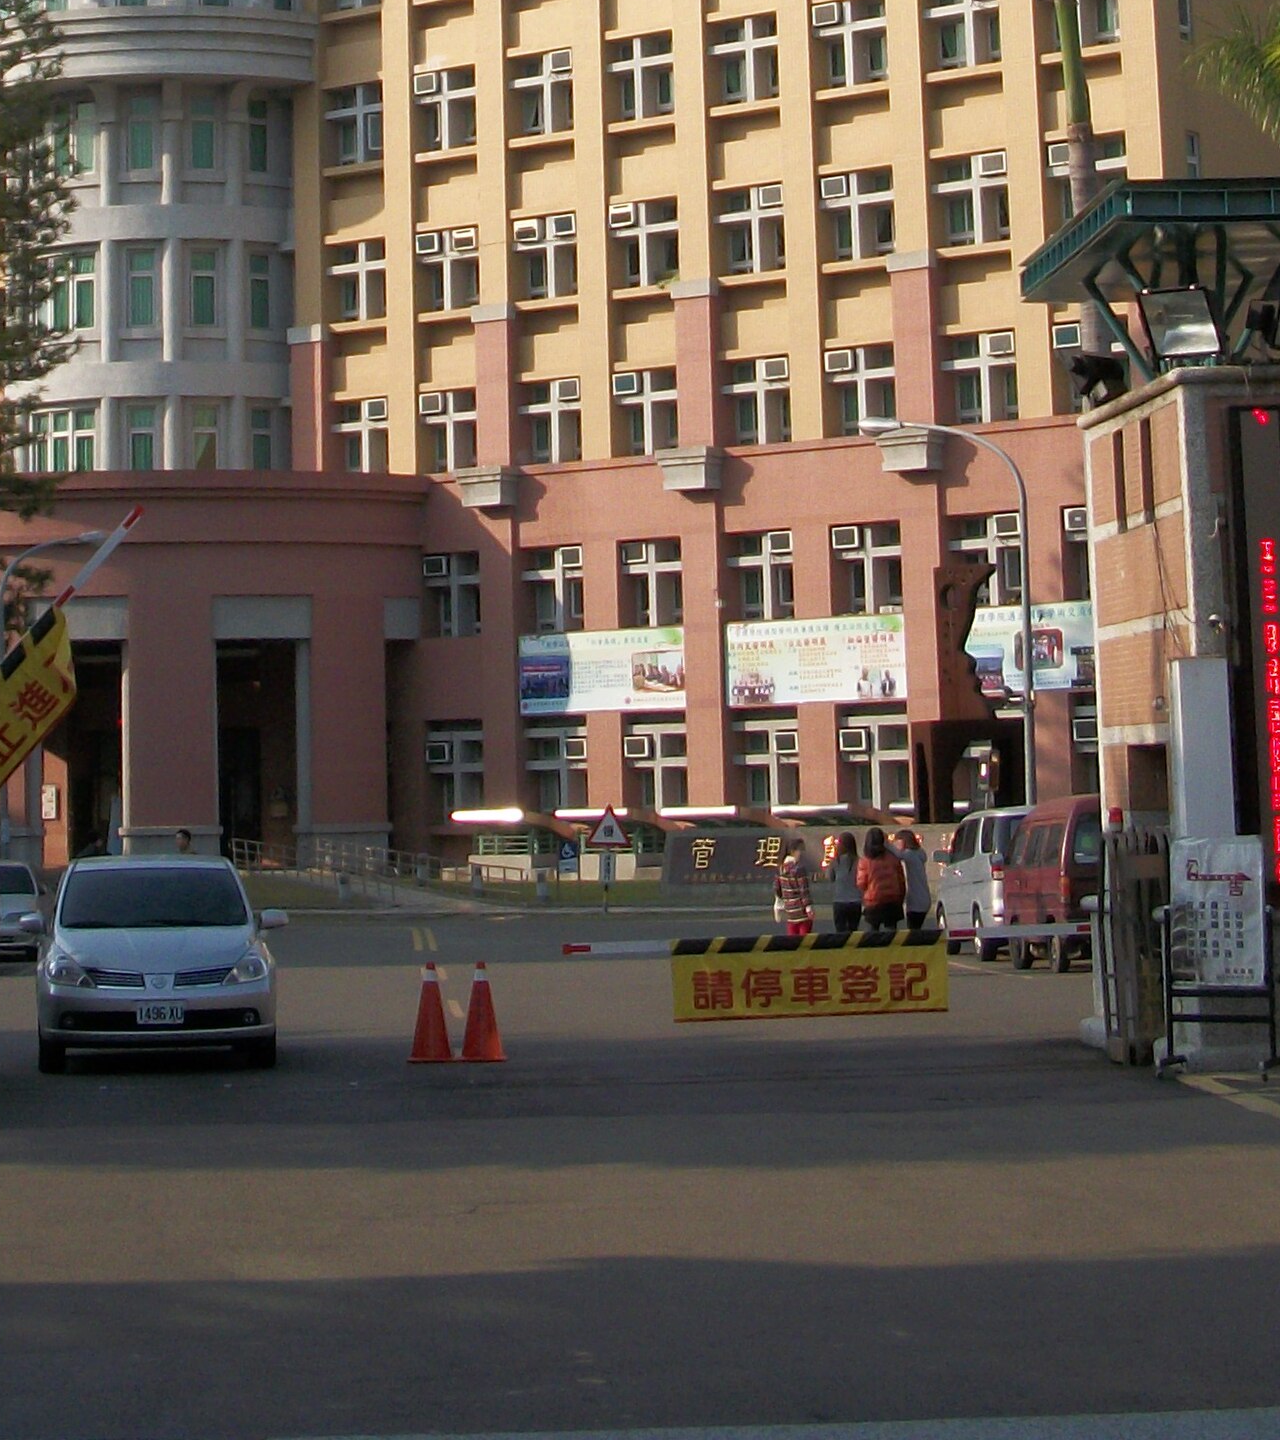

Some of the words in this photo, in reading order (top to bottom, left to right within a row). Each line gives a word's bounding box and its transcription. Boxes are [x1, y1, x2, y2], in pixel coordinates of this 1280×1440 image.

[693, 962, 932, 1011] 請停車登記
